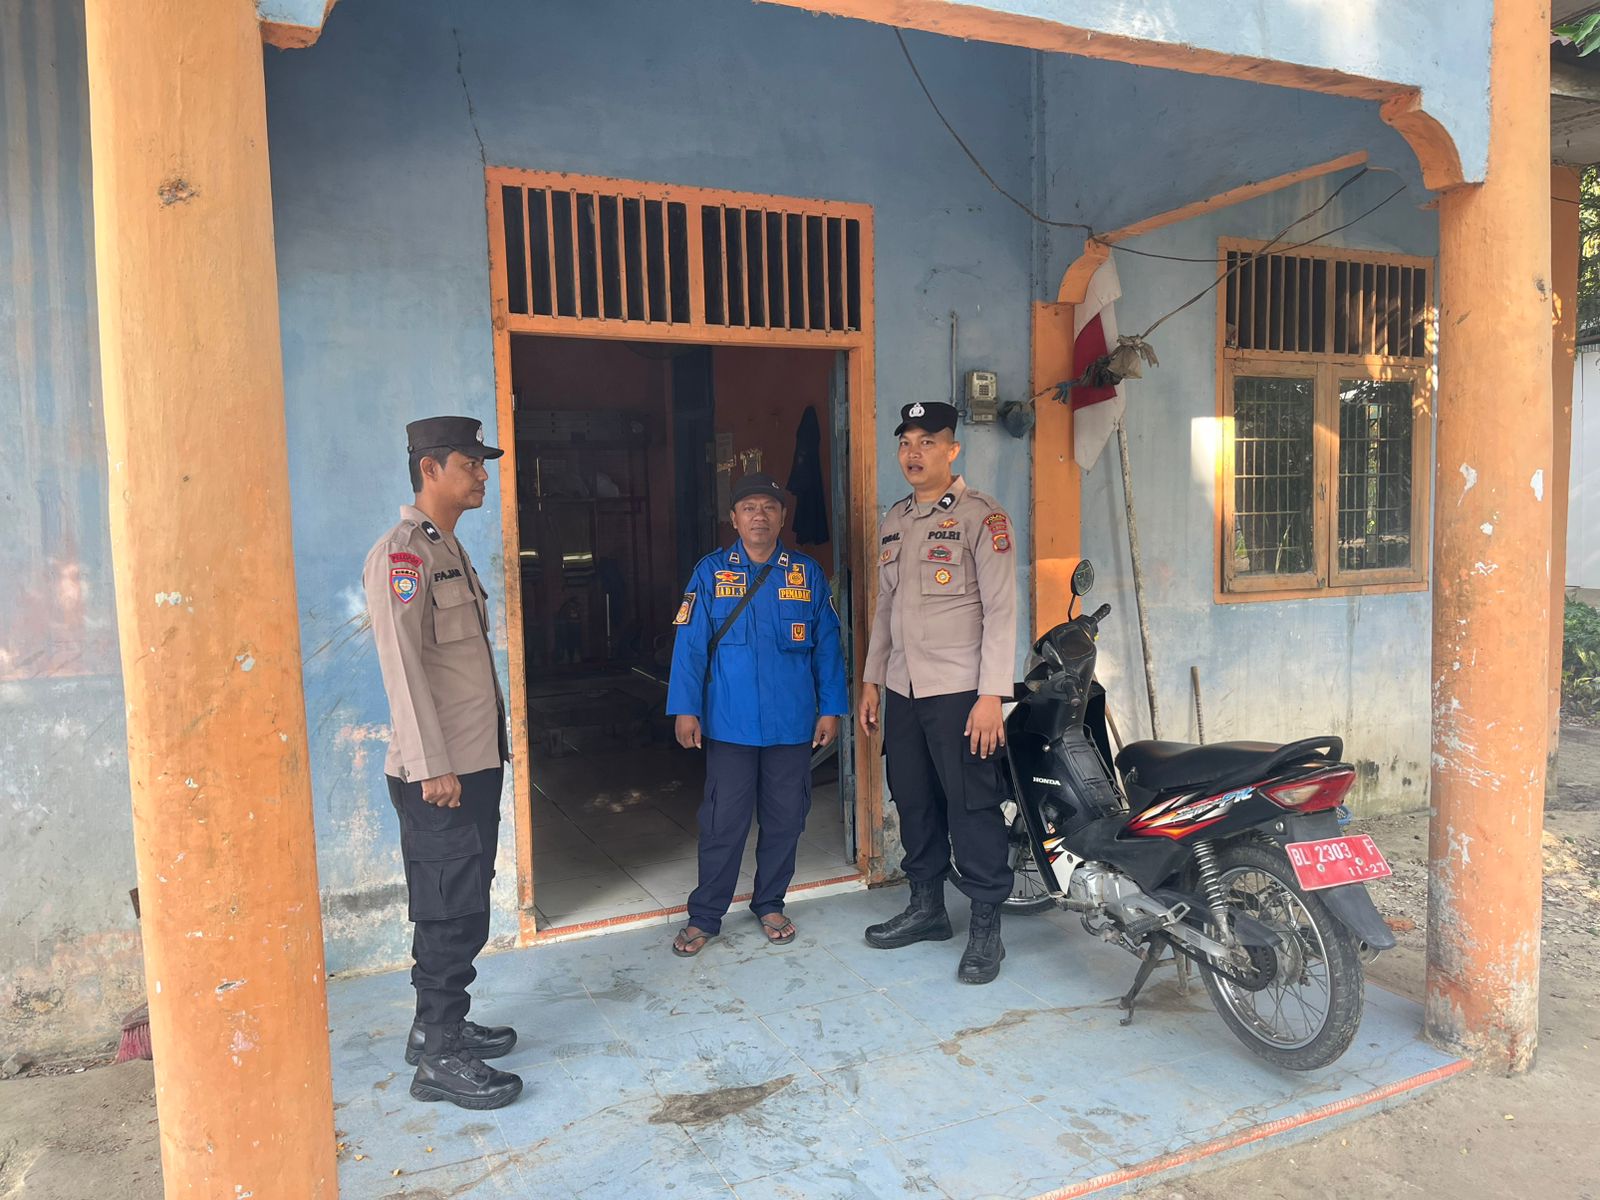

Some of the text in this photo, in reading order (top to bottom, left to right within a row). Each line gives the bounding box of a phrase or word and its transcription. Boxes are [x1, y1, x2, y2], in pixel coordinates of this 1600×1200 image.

[928, 531, 961, 541] POLRI
[434, 568, 462, 582] FAJAR
[1032, 776, 1062, 786] HONDA
[1290, 839, 1375, 866] BL 2303 F
